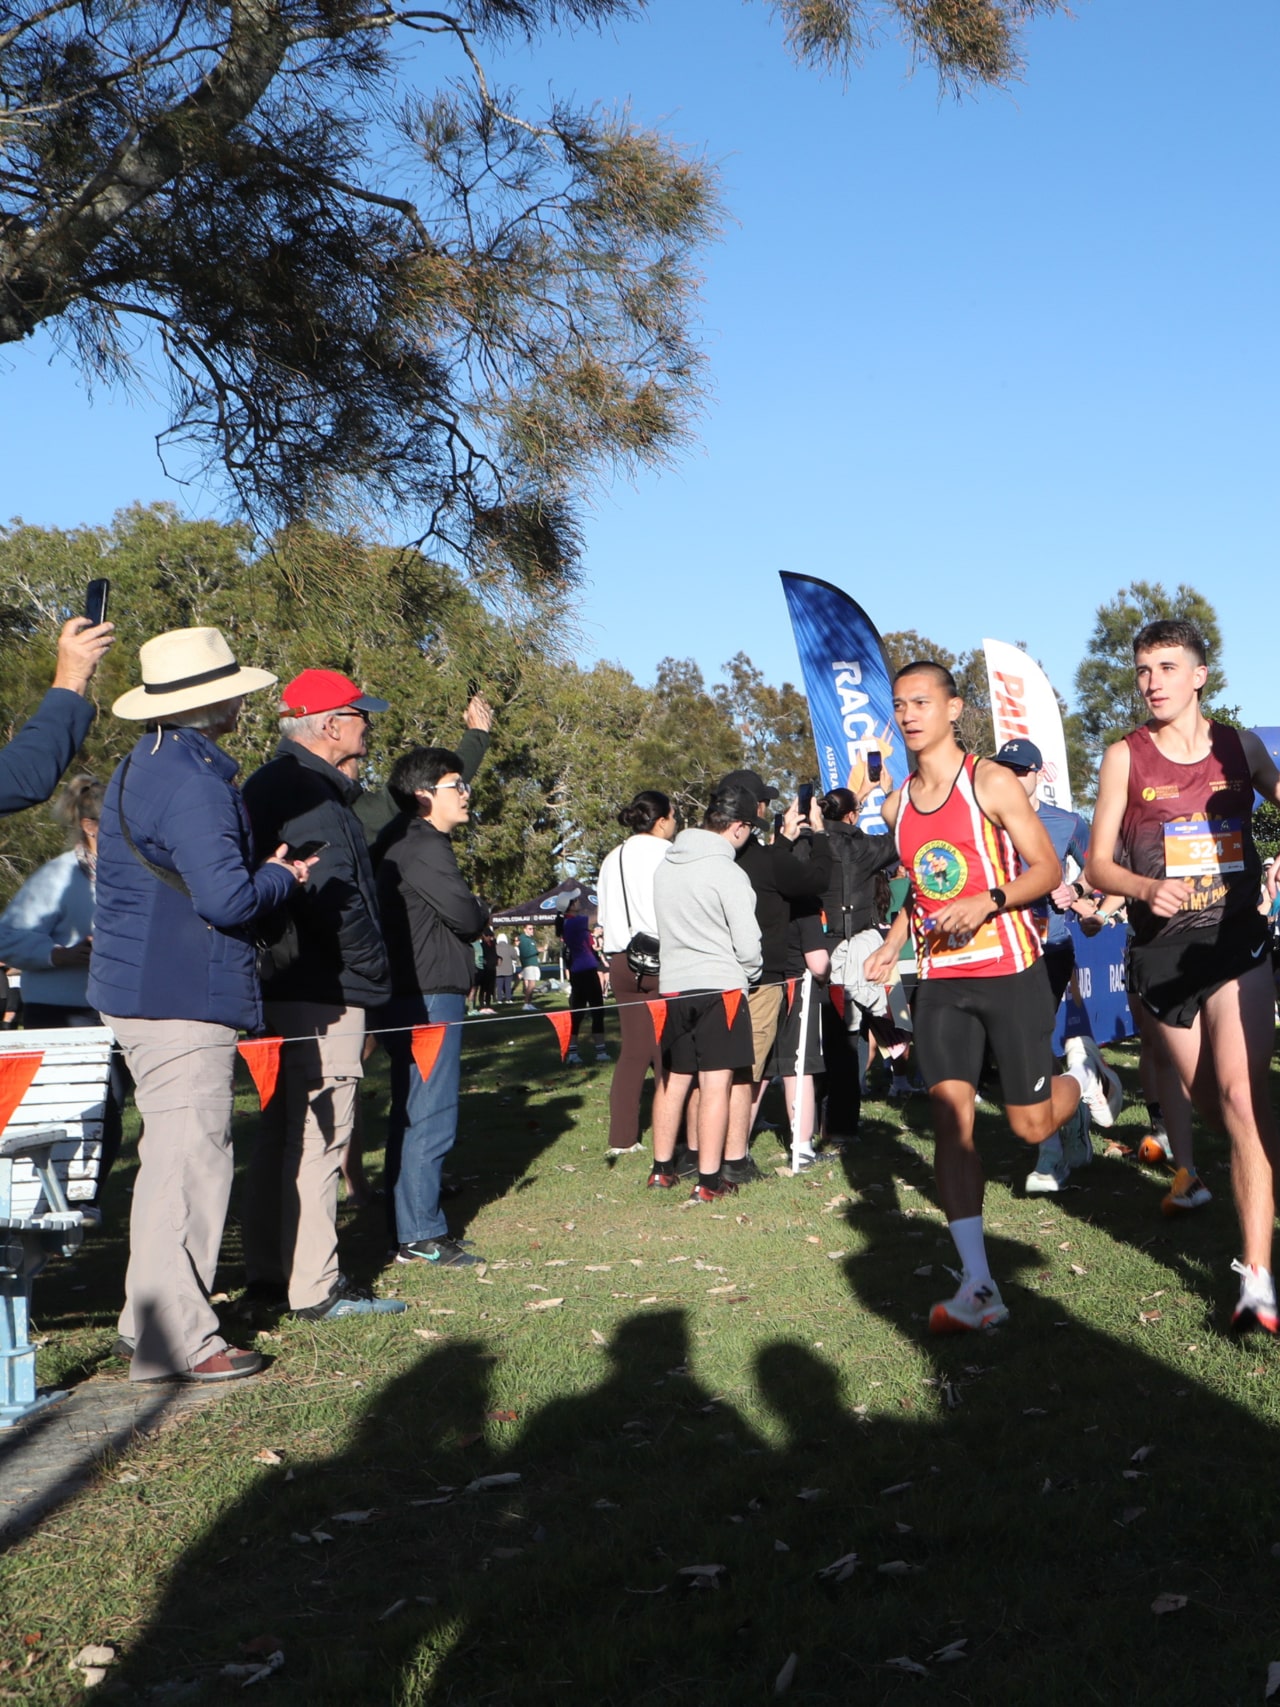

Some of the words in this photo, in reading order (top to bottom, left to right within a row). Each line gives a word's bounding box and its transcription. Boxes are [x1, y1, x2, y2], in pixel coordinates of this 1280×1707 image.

[832, 661, 880, 766] RACE
[860, 787, 890, 836] HU
[825, 746, 840, 790] AUSTRA
[1189, 840, 1224, 860] 324
[1109, 963, 1126, 993] RAC
